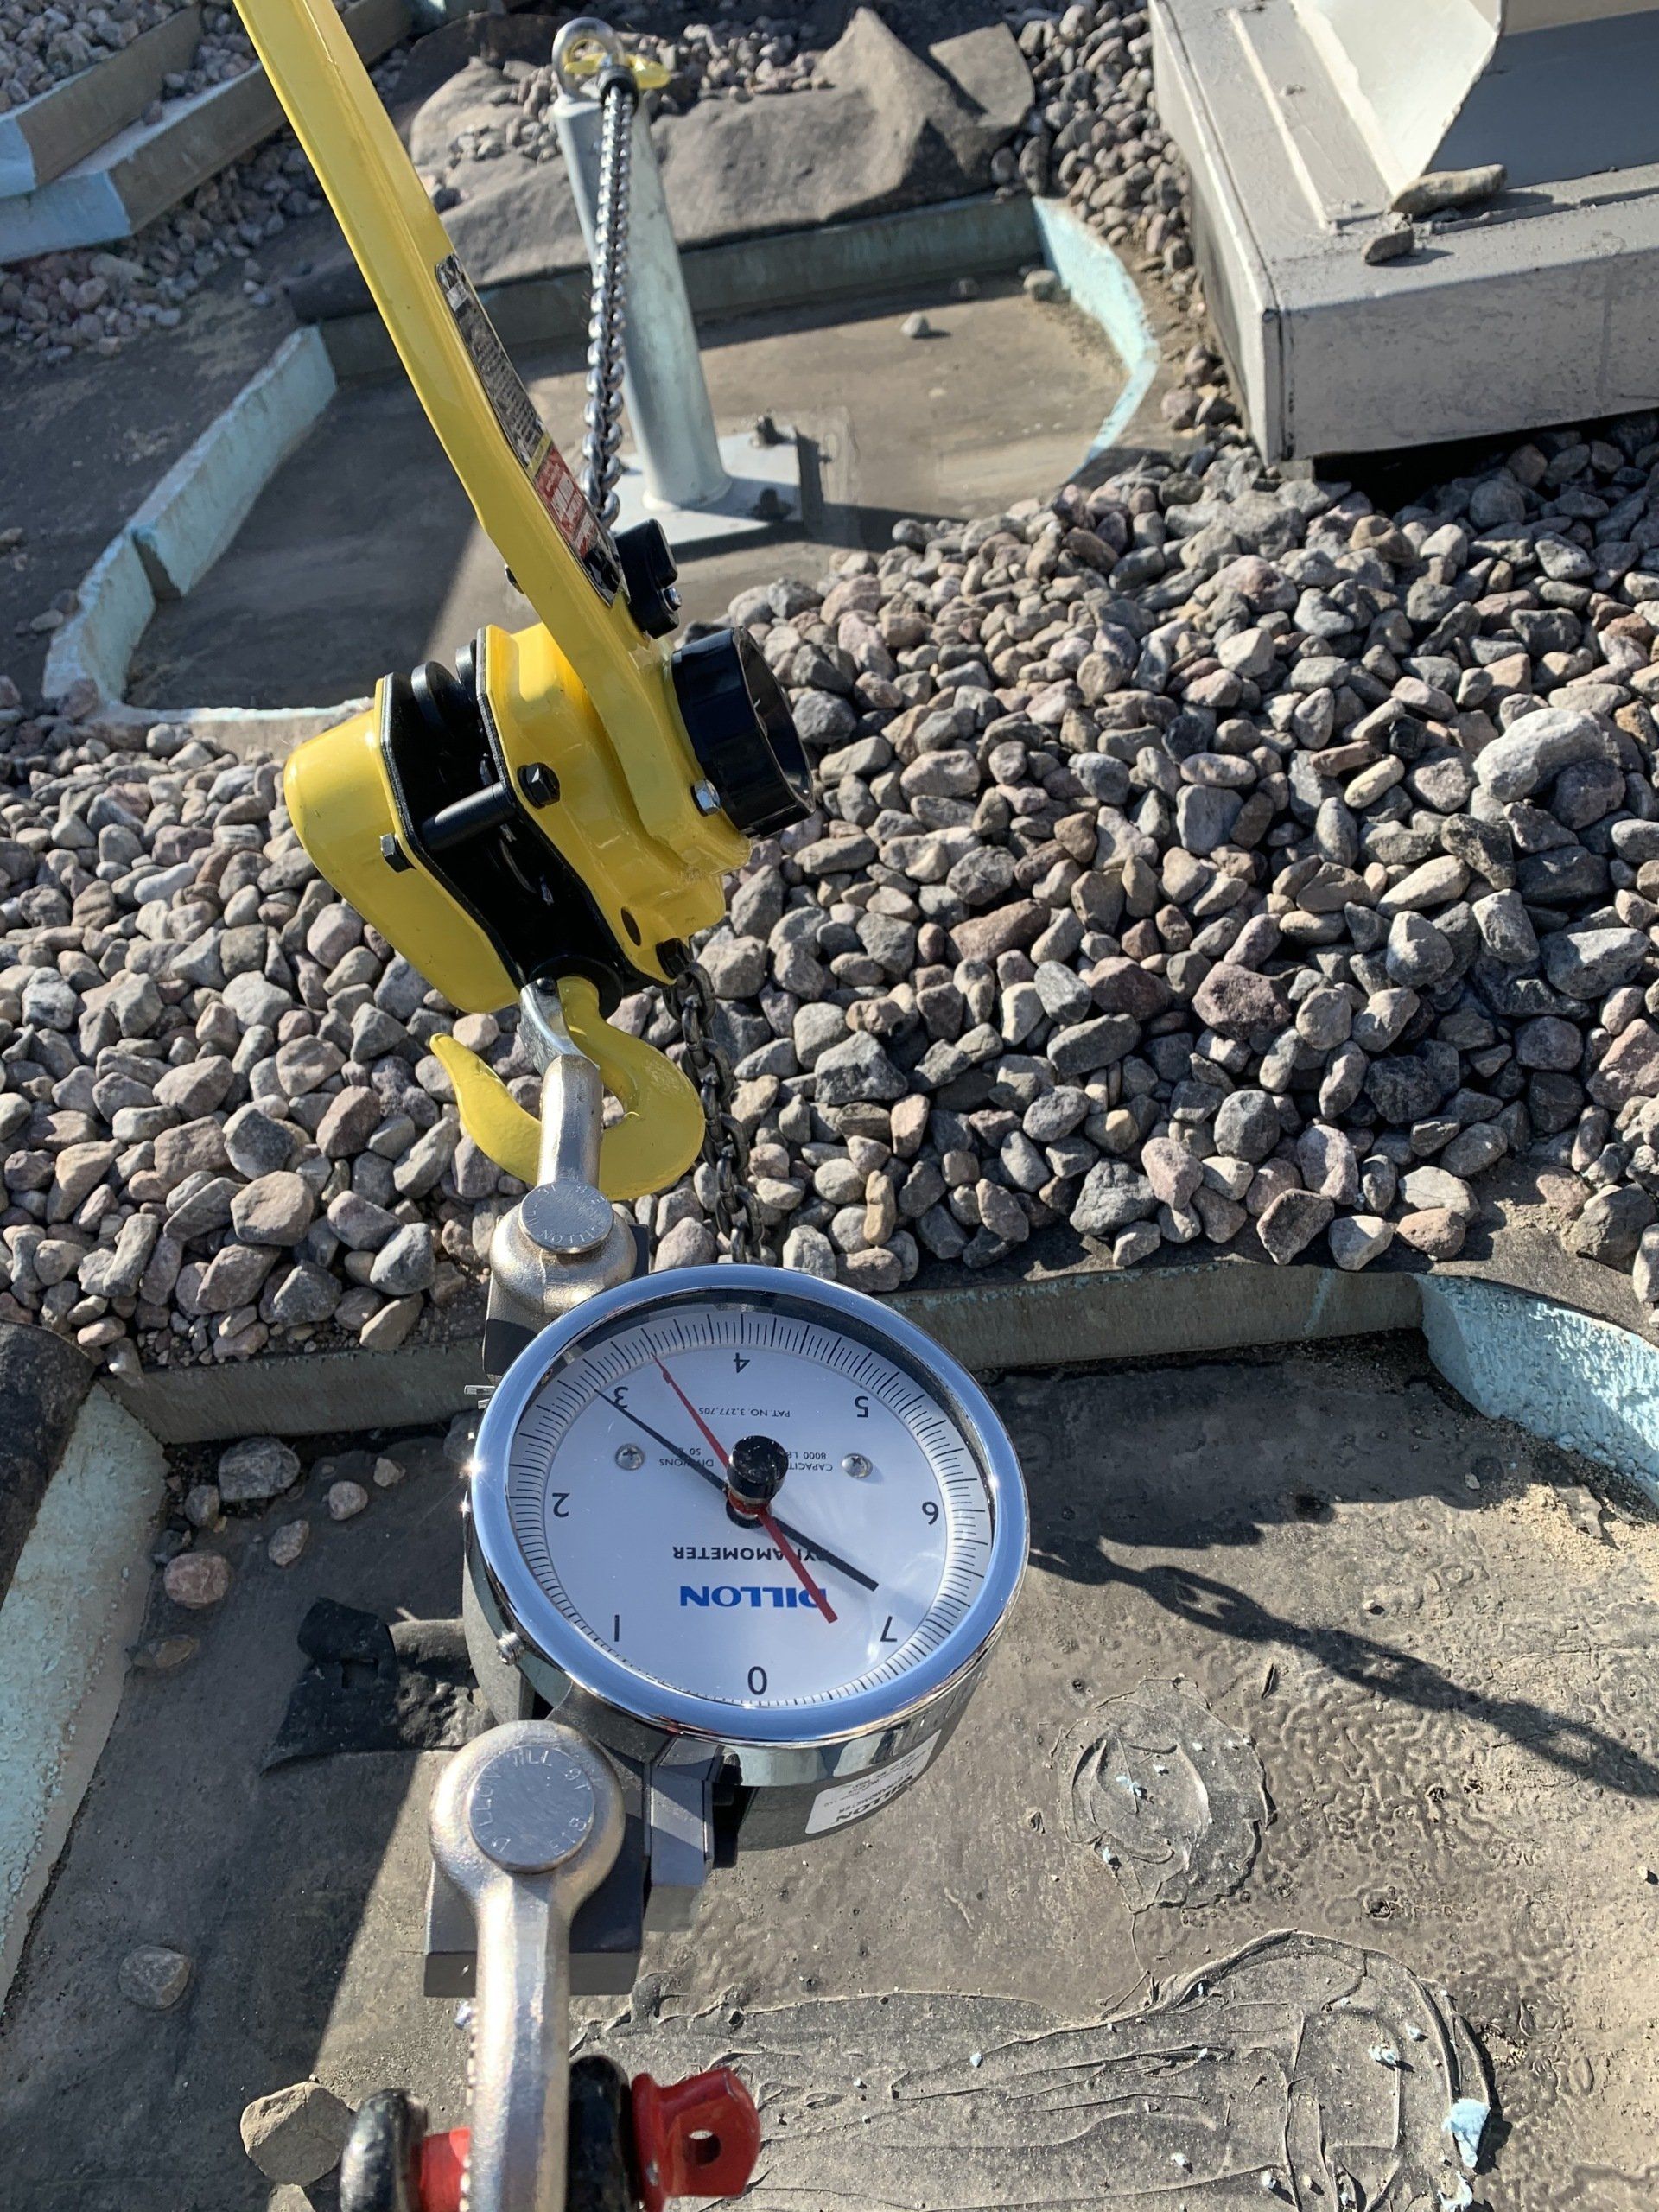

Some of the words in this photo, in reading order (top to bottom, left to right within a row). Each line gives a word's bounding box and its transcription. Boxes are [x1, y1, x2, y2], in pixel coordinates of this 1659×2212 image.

[733, 1352, 751, 1374] 4
[613, 1386, 630, 1409] 3
[854, 1395, 870, 1419] 5
[698, 1407, 747, 1415] 3,277,705
[750, 1408, 769, 1417] NO.
[770, 1409, 791, 1418] PAT.
[690, 1447, 702, 1456] 50
[803, 1452, 827, 1460] 8000
[787, 1461, 833, 1471] CAPACIT
[551, 1492, 570, 1519] 2
[921, 1500, 940, 1526] 6
[680, 1586, 827, 1608] DILLON
[613, 1614, 620, 1643] 1
[880, 1615, 898, 1643] 7
[747, 1665, 769, 1696] 0
